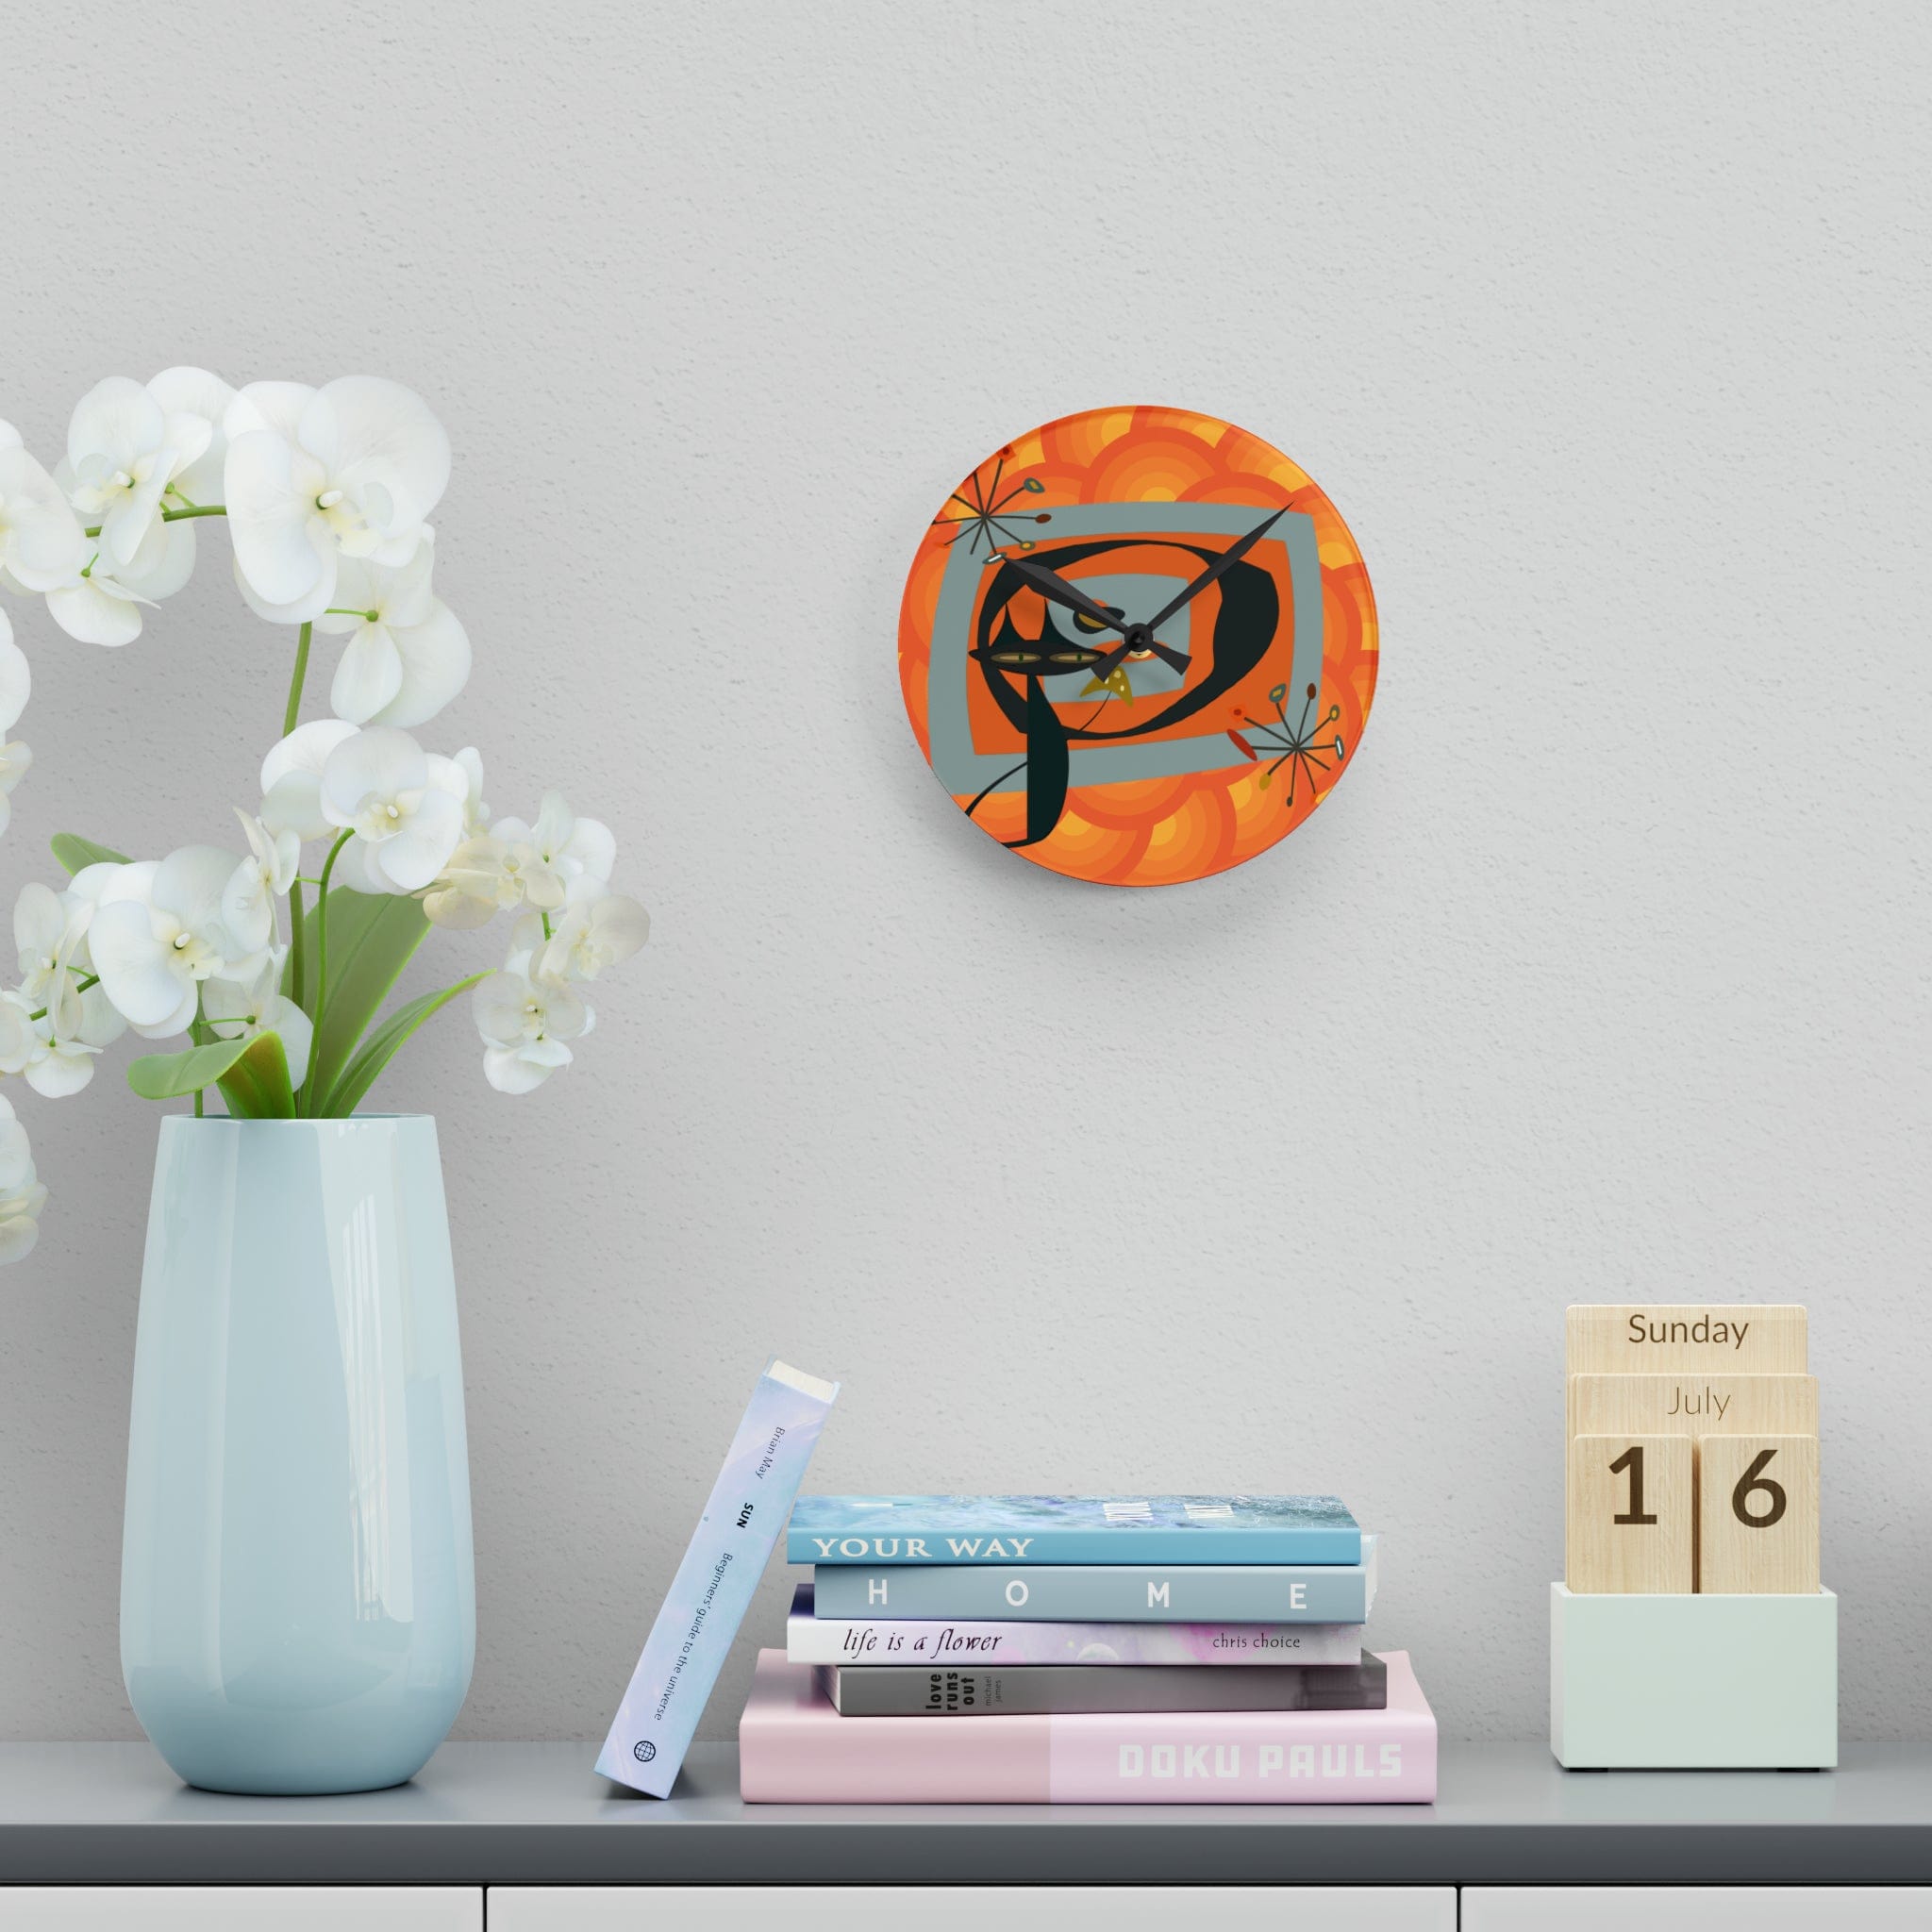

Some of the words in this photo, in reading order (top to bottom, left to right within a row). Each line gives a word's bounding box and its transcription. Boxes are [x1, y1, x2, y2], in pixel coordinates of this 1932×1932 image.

[1627, 1313, 1750, 1350] Sunday
[1667, 1386, 1731, 1422] July
[766, 1426, 786, 1455] Brian
[755, 1456, 774, 1479] May
[736, 1502, 755, 1529] SUN
[811, 1538, 933, 1557] YOUR
[945, 1538, 1035, 1557] WAY
[688, 1607, 708, 1641] guide
[682, 1642, 693, 1654] to
[842, 1628, 878, 1659] life
[887, 1632, 905, 1651] is
[913, 1636, 928, 1651] a
[929, 1628, 1003, 1659] flower
[1212, 1632, 1248, 1649] chris
[1252, 1632, 1301, 1649] choice
[674, 1656, 688, 1674] the
[654, 1675, 678, 1722] universe
[924, 1673, 942, 1710] love
[946, 1672, 958, 1711] runs
[960, 1676, 975, 1706] out
[984, 1675, 992, 1707] michael
[1118, 1744, 1241, 1779] DOKU
[1258, 1743, 1403, 1779] PAULS
